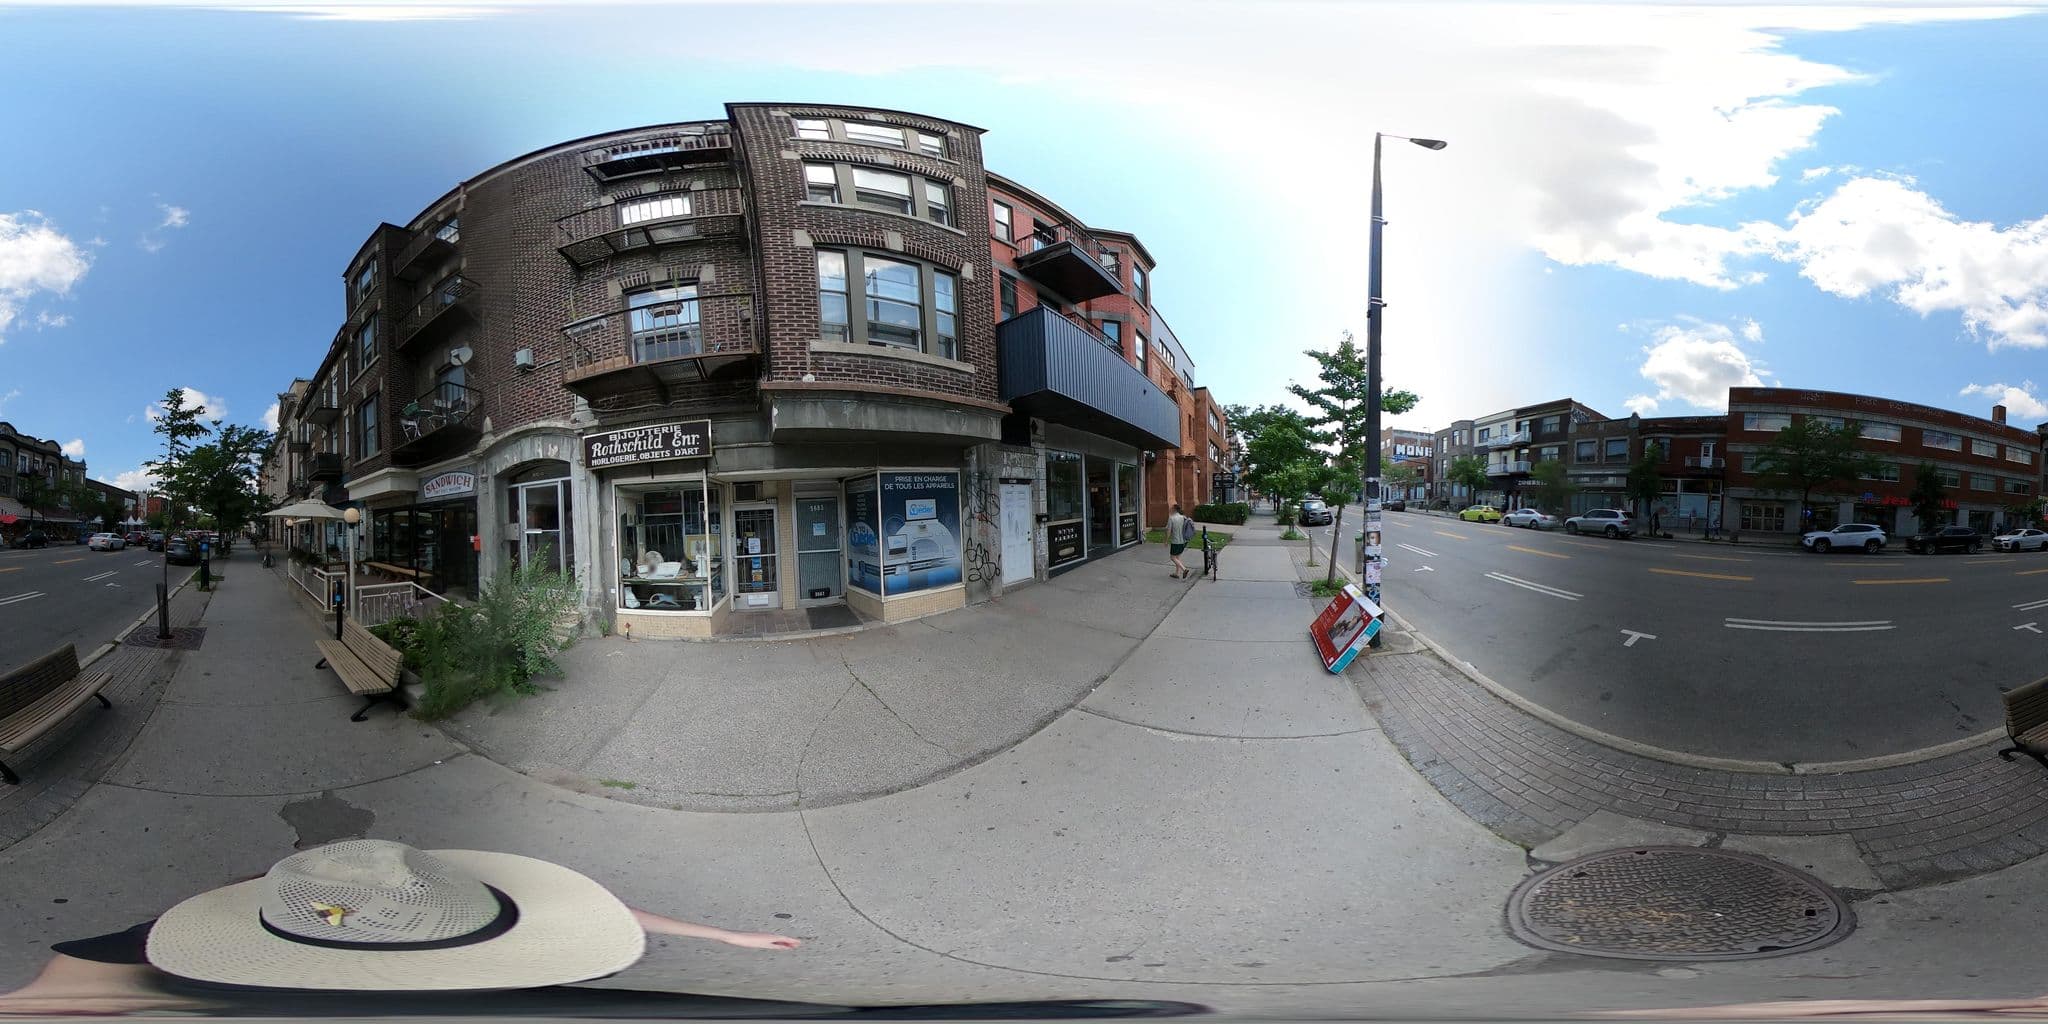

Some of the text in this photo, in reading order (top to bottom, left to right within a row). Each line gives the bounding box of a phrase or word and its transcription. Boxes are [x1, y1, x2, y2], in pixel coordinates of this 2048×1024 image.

[609, 425, 682, 441] BIJOUTERIE
[591, 431, 700, 458] Rothschild Enr.
[640, 450, 671, 460] OBJETS
[675, 447, 700, 456] D'ART
[425, 475, 471, 494] SANDWICH
